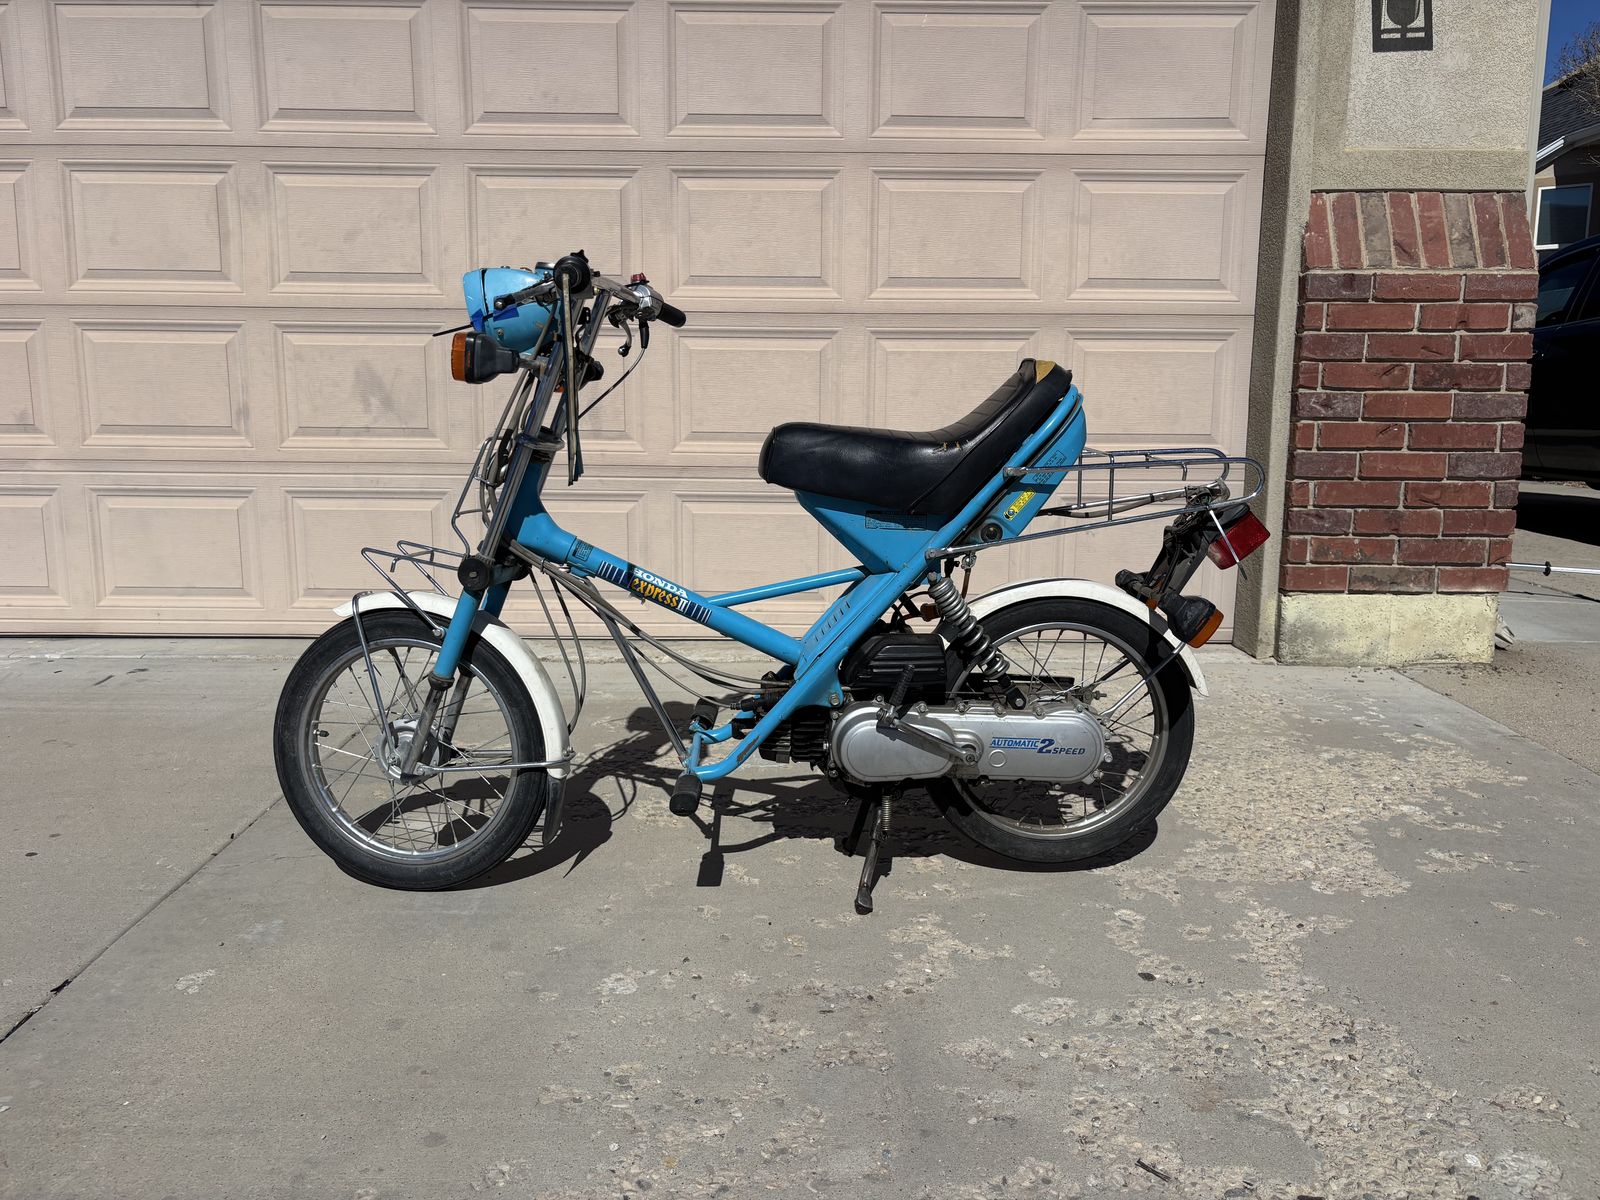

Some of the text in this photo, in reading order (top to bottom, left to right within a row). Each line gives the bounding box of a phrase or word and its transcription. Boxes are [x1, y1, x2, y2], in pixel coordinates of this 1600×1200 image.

[633, 567, 689, 599] HONDA
[991, 738, 1086, 755] AUTOMATIC 2 SPEED
